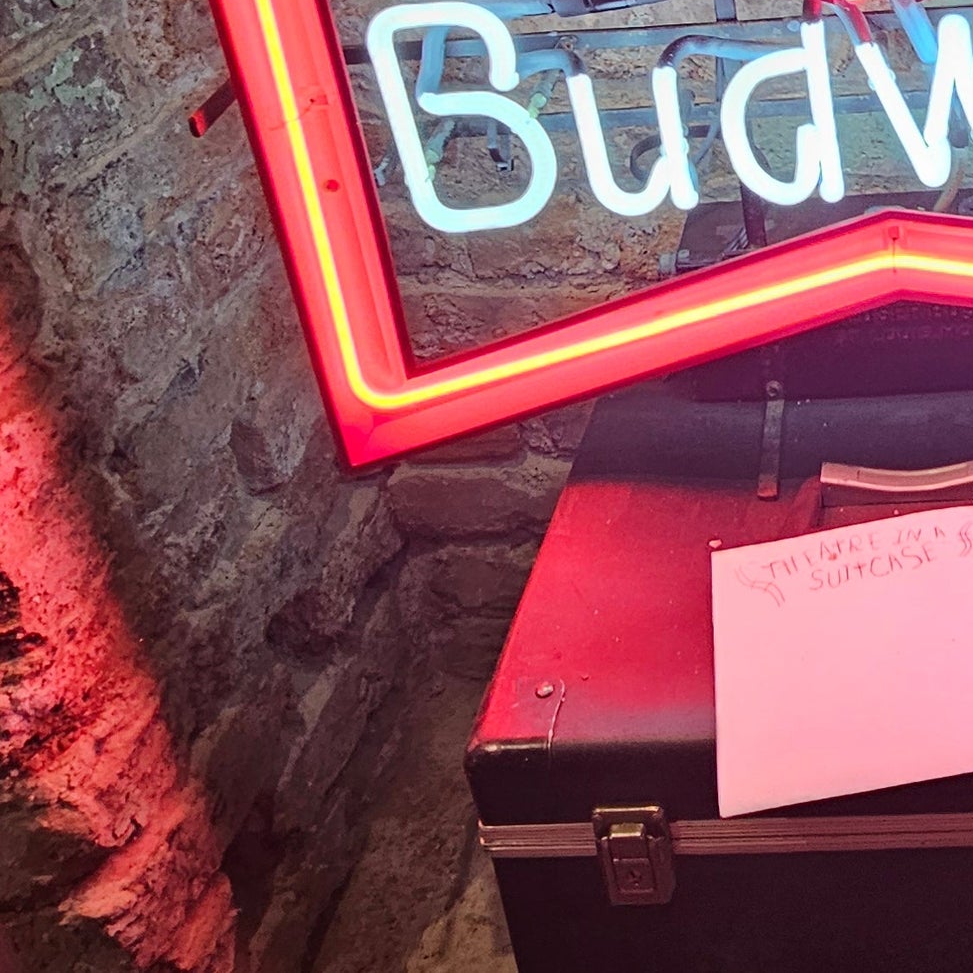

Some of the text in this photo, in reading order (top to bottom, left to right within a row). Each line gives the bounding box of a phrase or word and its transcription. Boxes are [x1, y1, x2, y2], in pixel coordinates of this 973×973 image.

[761, 533, 881, 579] THEATRE
[892, 527, 922, 546] IN
[809, 541, 938, 591] SUITCASE
